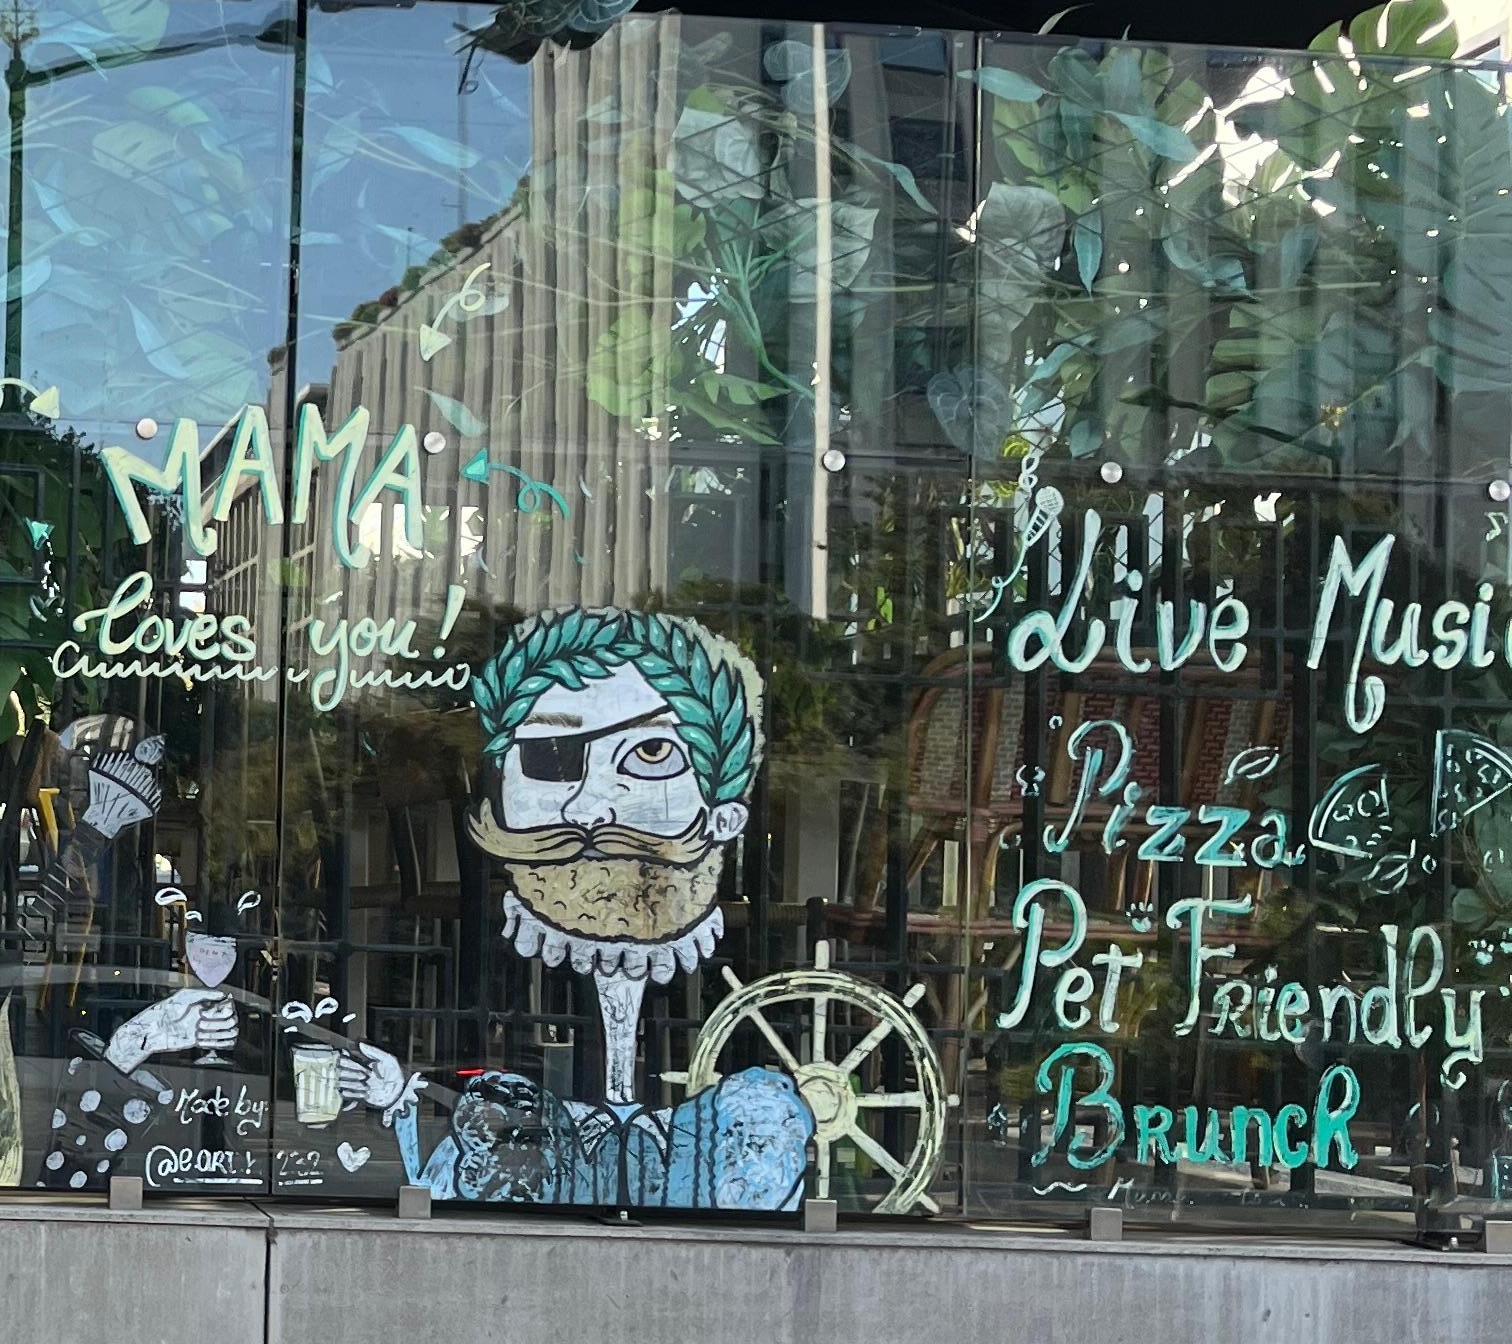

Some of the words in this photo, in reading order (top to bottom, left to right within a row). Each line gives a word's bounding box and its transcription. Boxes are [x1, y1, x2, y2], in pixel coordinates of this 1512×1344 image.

[100, 403, 425, 569] MAMA
[1007, 509, 1250, 673] Live
[1306, 533, 1512, 734] Musi
[1043, 718, 1307, 869] Pizza
[996, 877, 1144, 1035] Pet
[175, 1086, 231, 1124] Made
